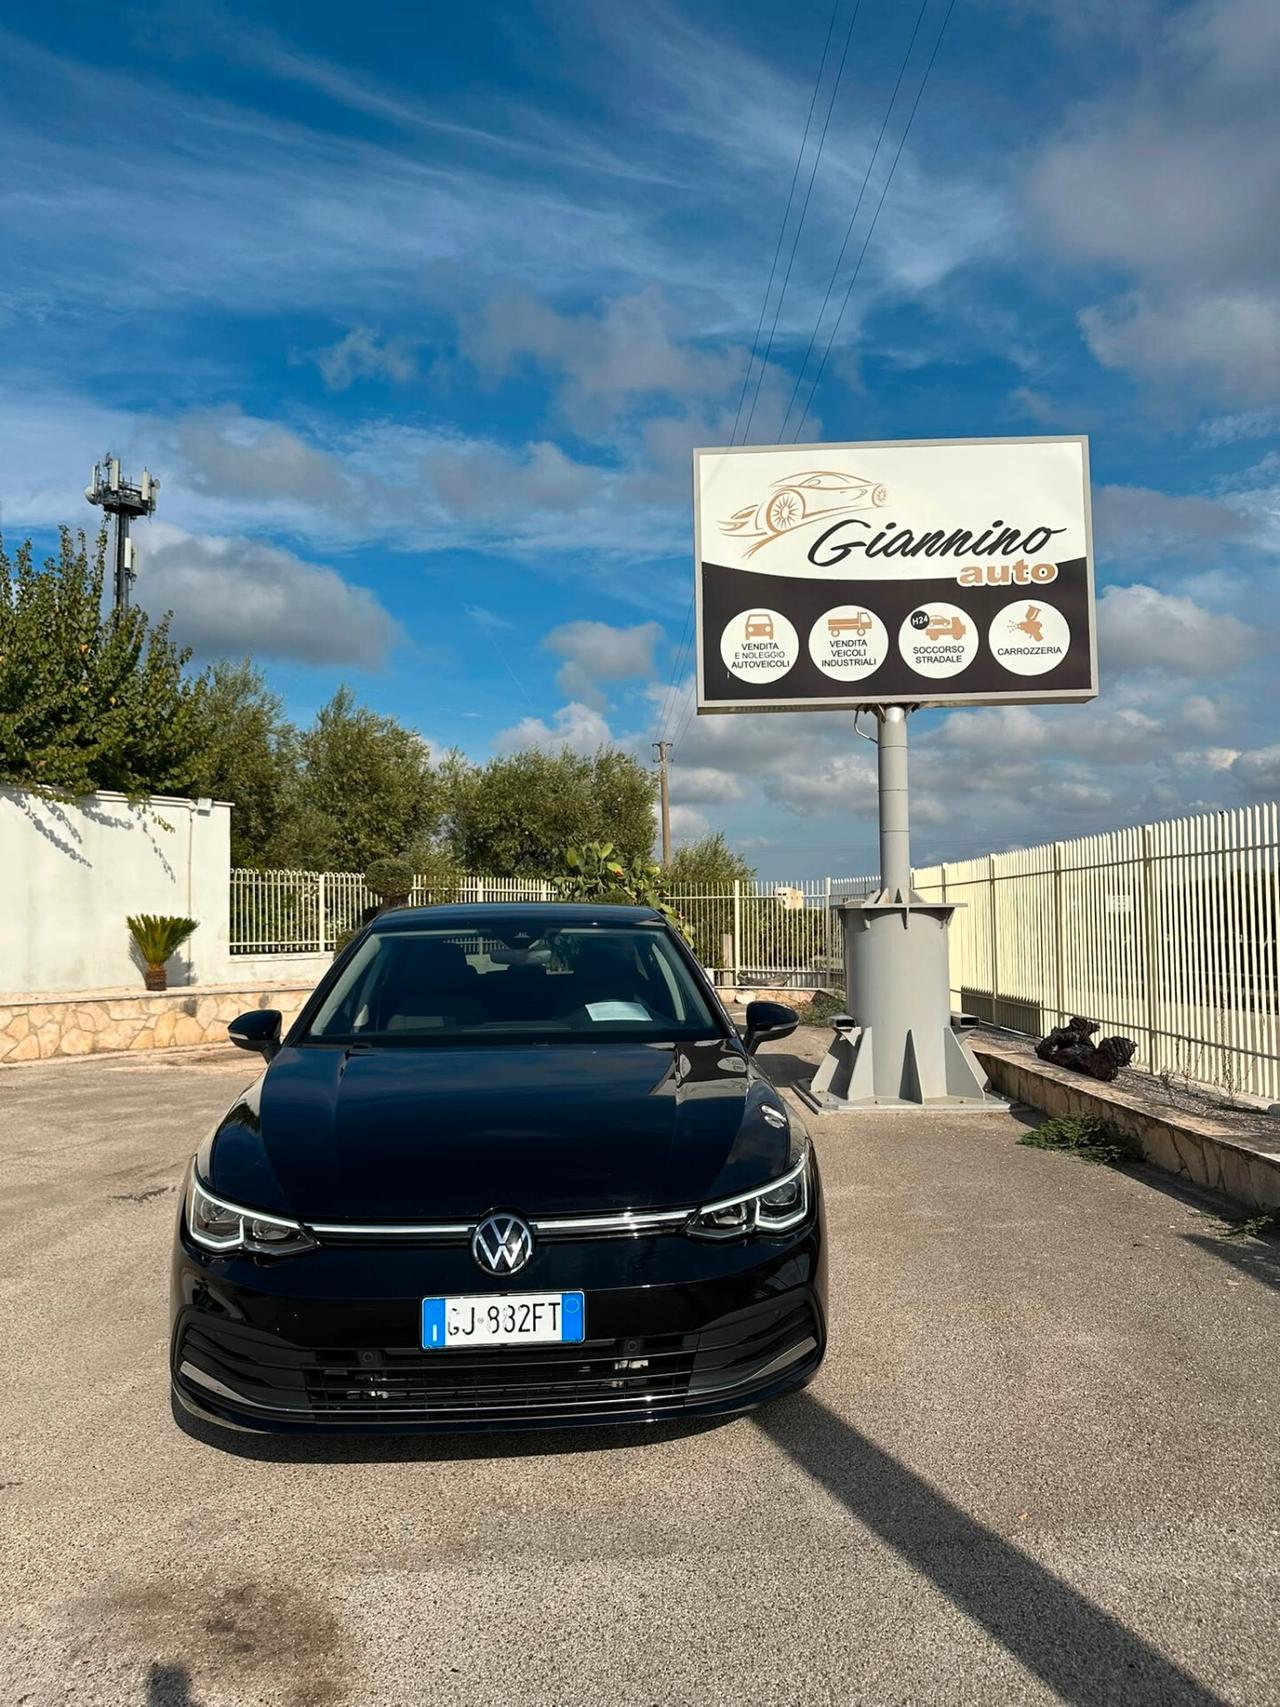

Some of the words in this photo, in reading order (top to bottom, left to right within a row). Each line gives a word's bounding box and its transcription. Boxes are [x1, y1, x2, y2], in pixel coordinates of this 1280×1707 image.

[807, 519, 1067, 567] Giannino
[959, 558, 1057, 585] auto
[911, 615, 929, 626] H24
[741, 642, 779, 651] VENDITA
[829, 639, 868, 648] VENDITA
[831, 648, 867, 658] VEICOLI
[912, 645, 965, 655] SOCCORSO
[997, 646, 1063, 656] CARROZZERIA
[734, 652, 740, 660] E
[742, 651, 785, 660] NOLEGGIO
[915, 655, 963, 664] STRADALE
[731, 660, 790, 669] AUTOVEICOLI
[821, 658, 877, 667] INDUSTRIALI
